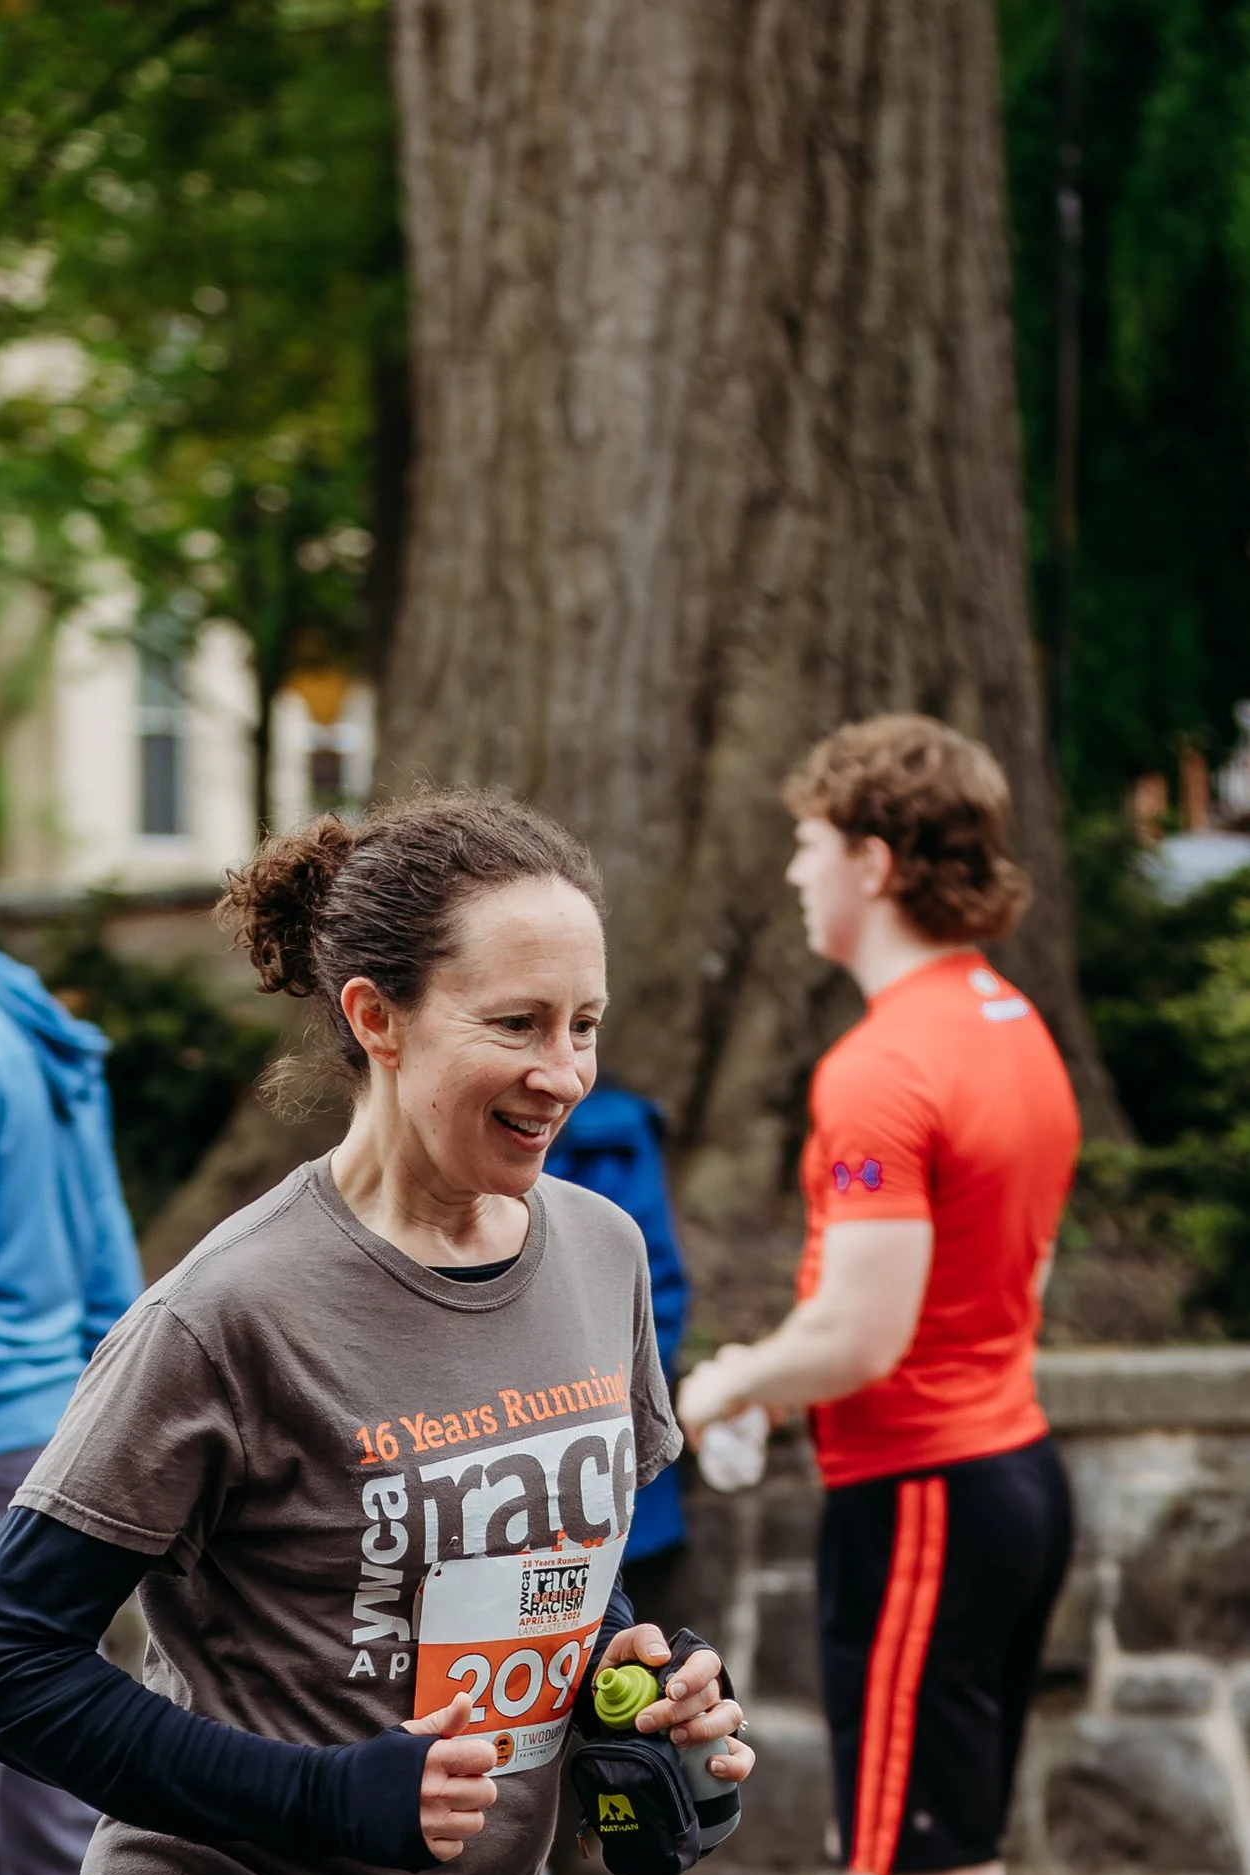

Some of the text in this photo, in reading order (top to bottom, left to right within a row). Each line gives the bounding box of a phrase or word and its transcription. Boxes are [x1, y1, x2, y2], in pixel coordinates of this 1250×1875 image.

[355, 1421, 400, 1465] 16
[399, 1404, 498, 1452] Years
[352, 1473, 410, 1644] ywca
[534, 1558, 555, 1567] Years
[532, 1568, 589, 1593] race
[519, 1570, 531, 1616] ywca
[533, 1586, 584, 1604] against
[530, 1597, 584, 1616] RACISM
[519, 1617, 544, 1626] APRIL
[600, 1823, 639, 1832] NATHAN
